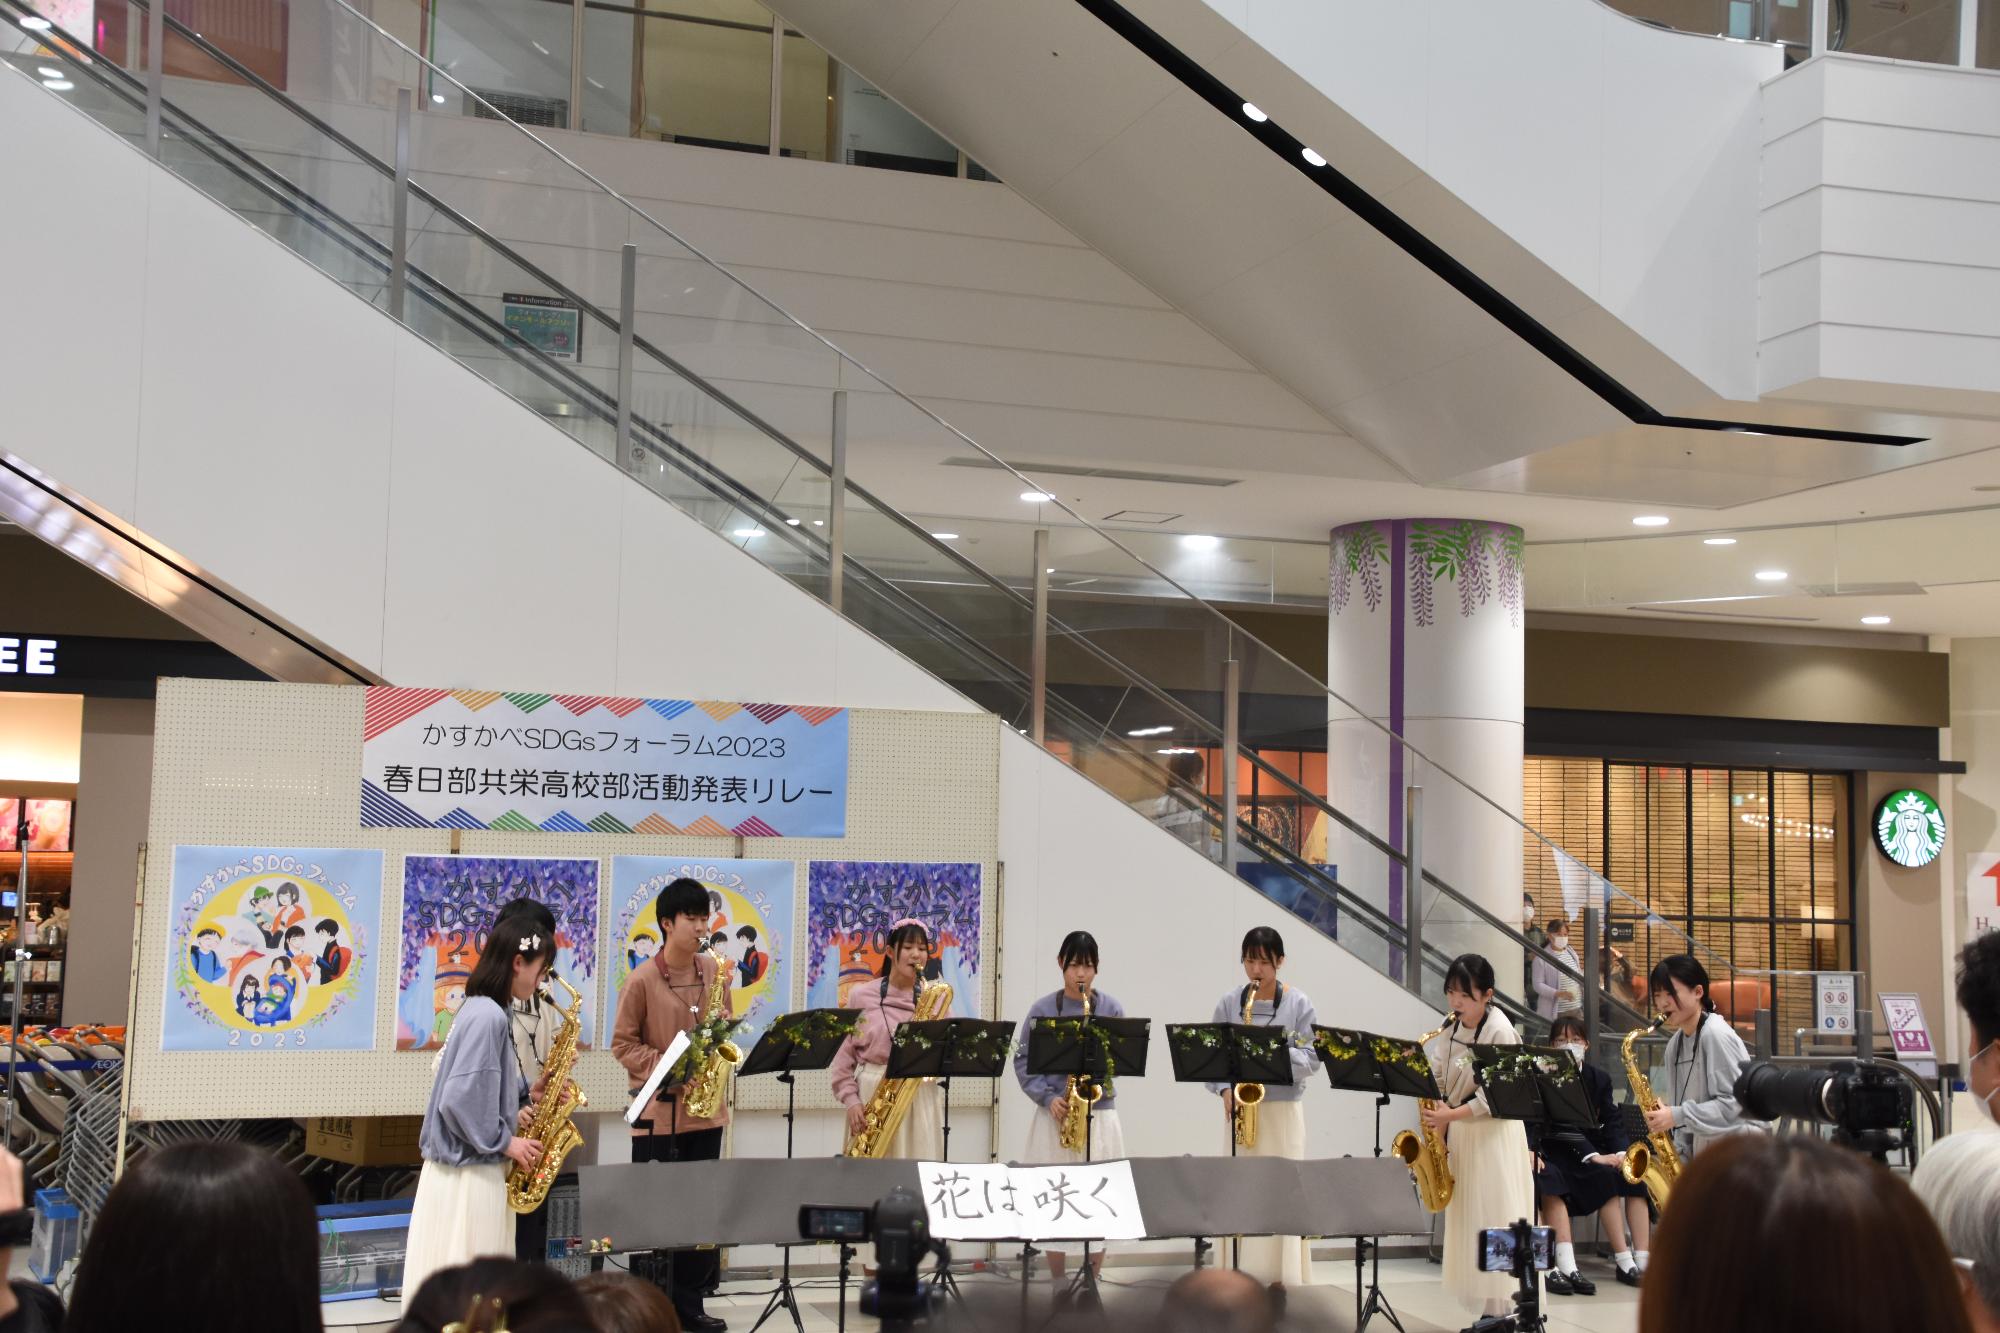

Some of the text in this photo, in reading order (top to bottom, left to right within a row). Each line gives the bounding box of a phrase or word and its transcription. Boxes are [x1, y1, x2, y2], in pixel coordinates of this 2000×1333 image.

[525, 297, 562, 306] Information
[422, 723, 786, 758] かすかべSDGsフォーラム2023
[383, 764, 833, 804] 春日部共栄高校部活動発表リレー
[849, 927, 938, 956] 203
[227, 1028, 306, 1048] 2023
[931, 1170, 1118, 1222] 花は咲く
